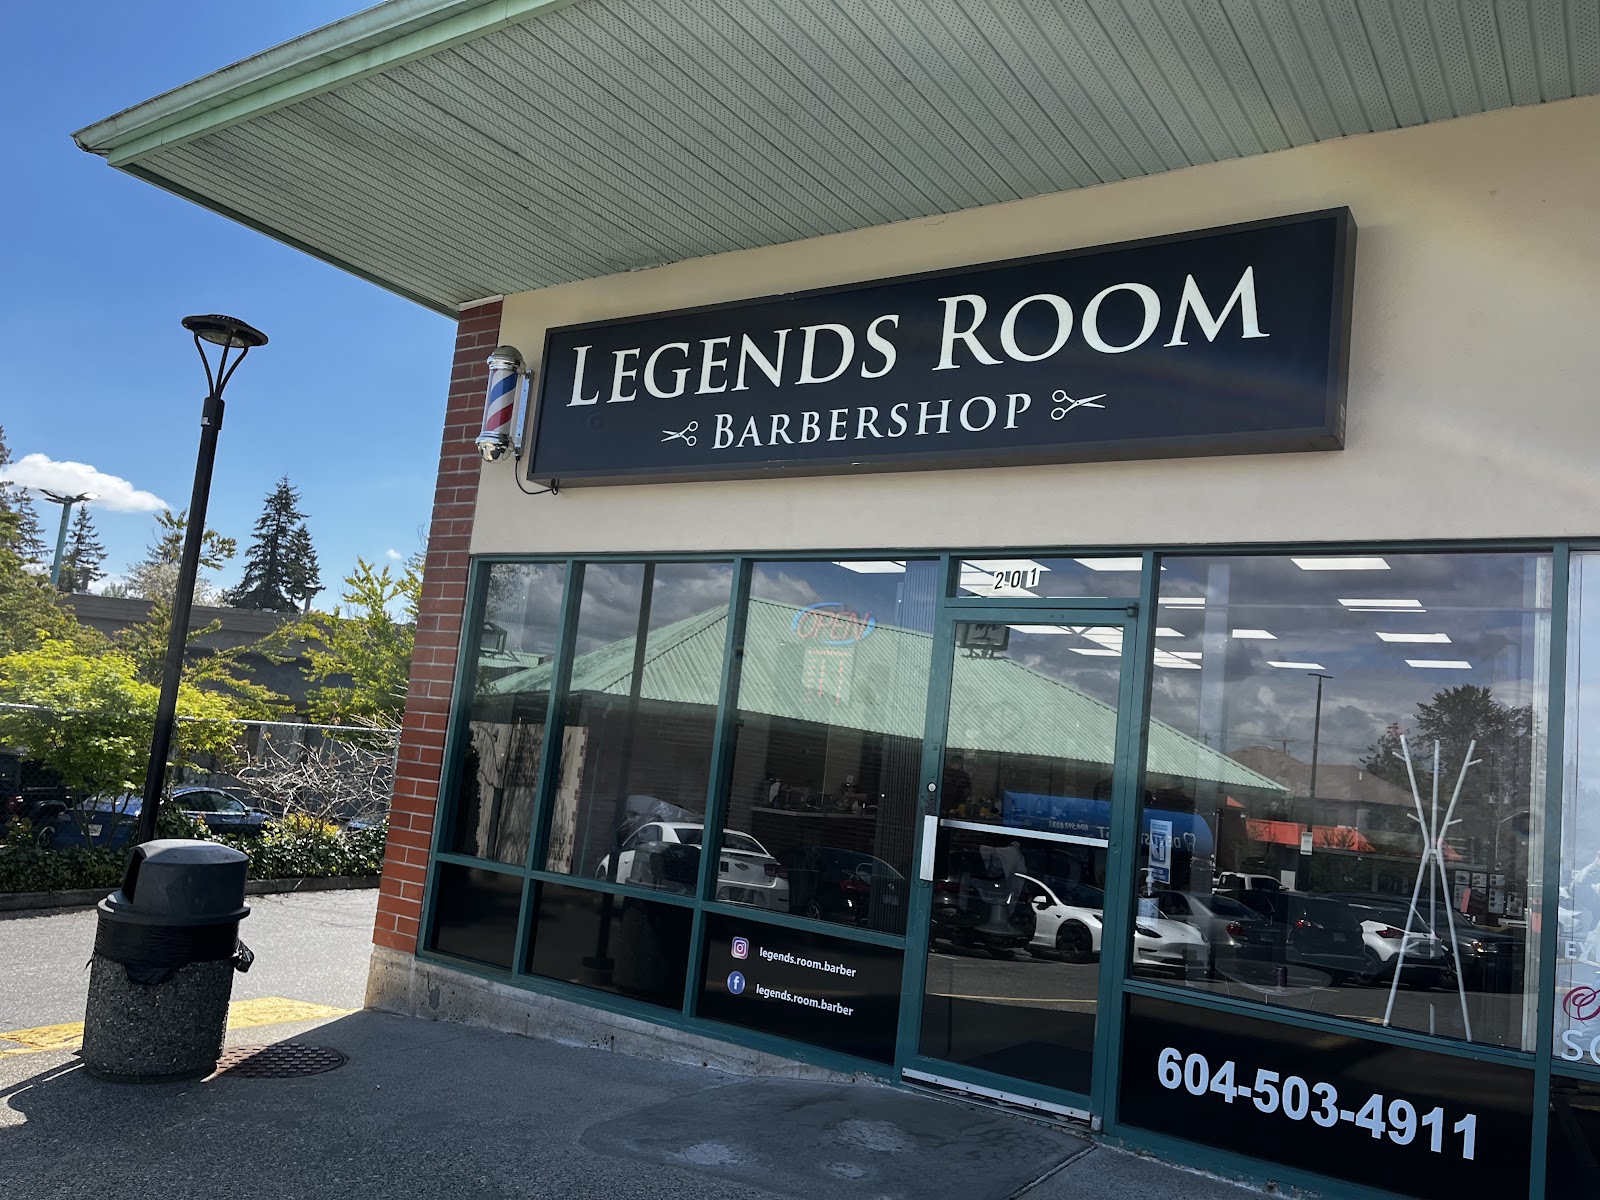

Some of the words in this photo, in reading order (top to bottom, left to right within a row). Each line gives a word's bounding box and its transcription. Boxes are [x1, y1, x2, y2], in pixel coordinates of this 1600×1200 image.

[566, 314, 902, 407] LEGENDS
[932, 265, 1270, 371] ROOM
[711, 393, 1032, 450] BARBERSHOP
[994, 567, 1037, 590] 201
[797, 610, 871, 641] OPEN
[759, 946, 857, 978] legends.room.barber
[1564, 940, 1600, 962] EY
[755, 983, 854, 1016] legends.room.barber
[1157, 1047, 1477, 1161] 604-503-4911
